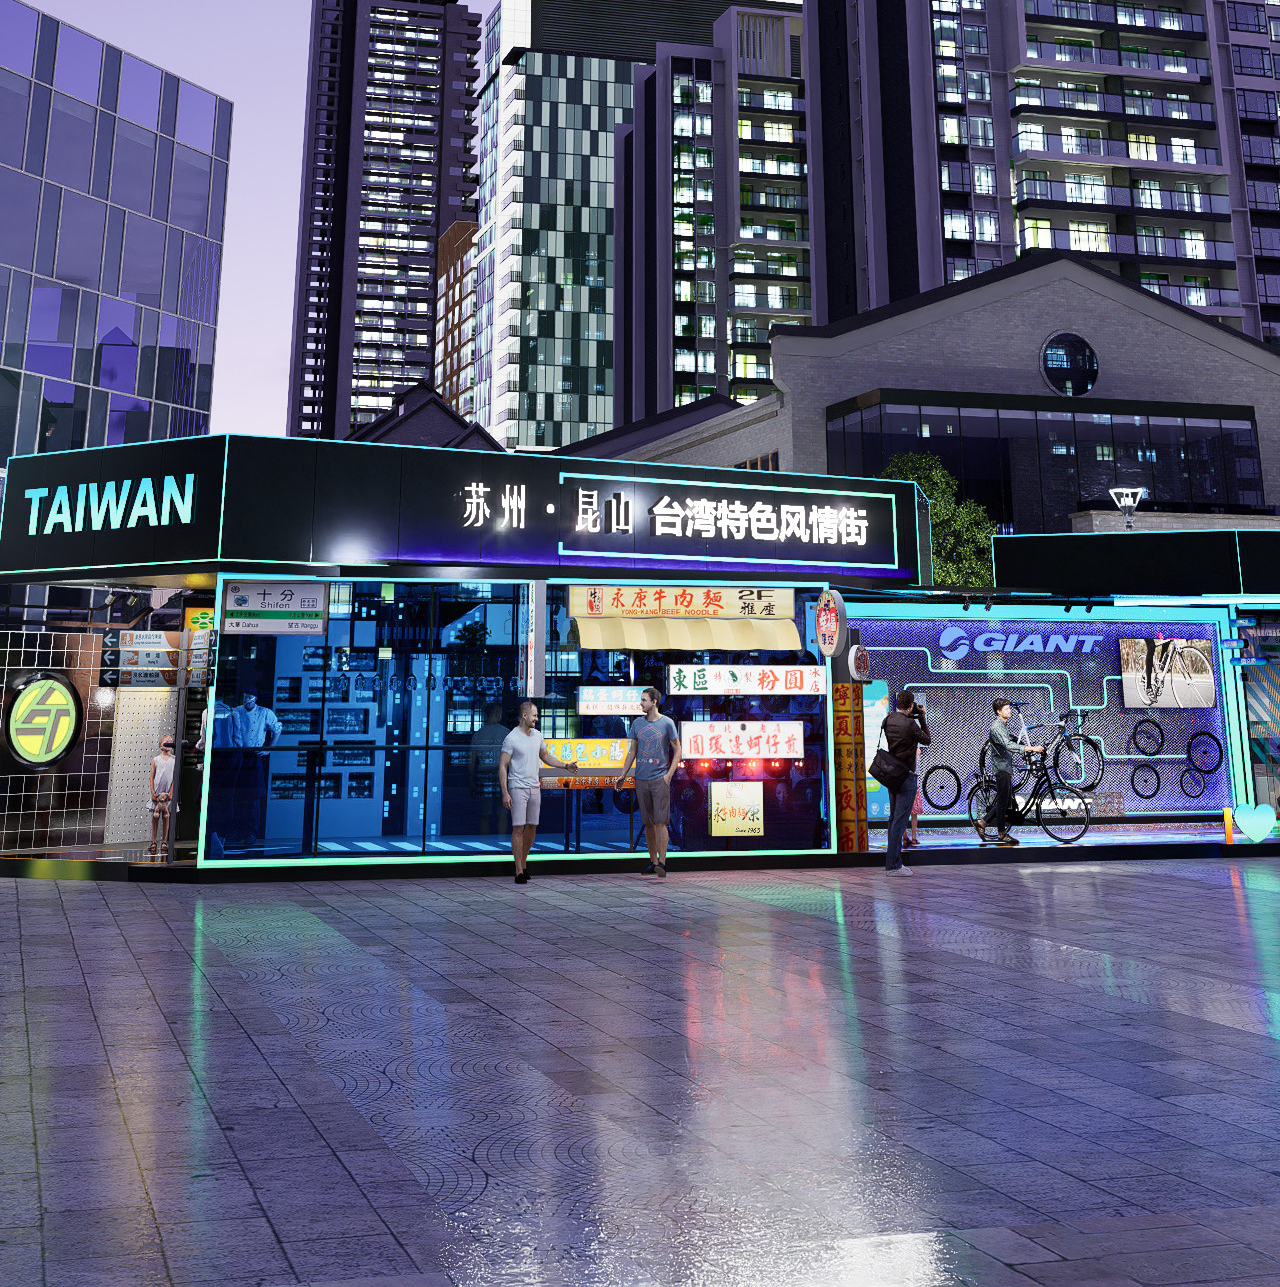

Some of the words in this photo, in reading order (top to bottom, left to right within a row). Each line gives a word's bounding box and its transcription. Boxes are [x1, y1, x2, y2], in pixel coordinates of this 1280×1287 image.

[24, 473, 196, 535] TAIWAN
[653, 496, 869, 546] 台湾特色风情街
[257, 588, 295, 602] 十分
[260, 601, 290, 609] Shifen
[611, 587, 724, 612] 永康牛肉麵
[738, 589, 775, 601] 2F
[621, 608, 659, 616] YONG-KANG
[661, 608, 681, 616] BEEF
[739, 602, 776, 616] 雅座
[974, 632, 1104, 653] GIANT
[672, 668, 709, 692] 東區
[757, 669, 804, 691] 粉圓
[809, 667, 821, 693] 冰店
[689, 733, 799, 756] 圓環邊蚵仔煎
[1223, 807, 1234, 845] I
